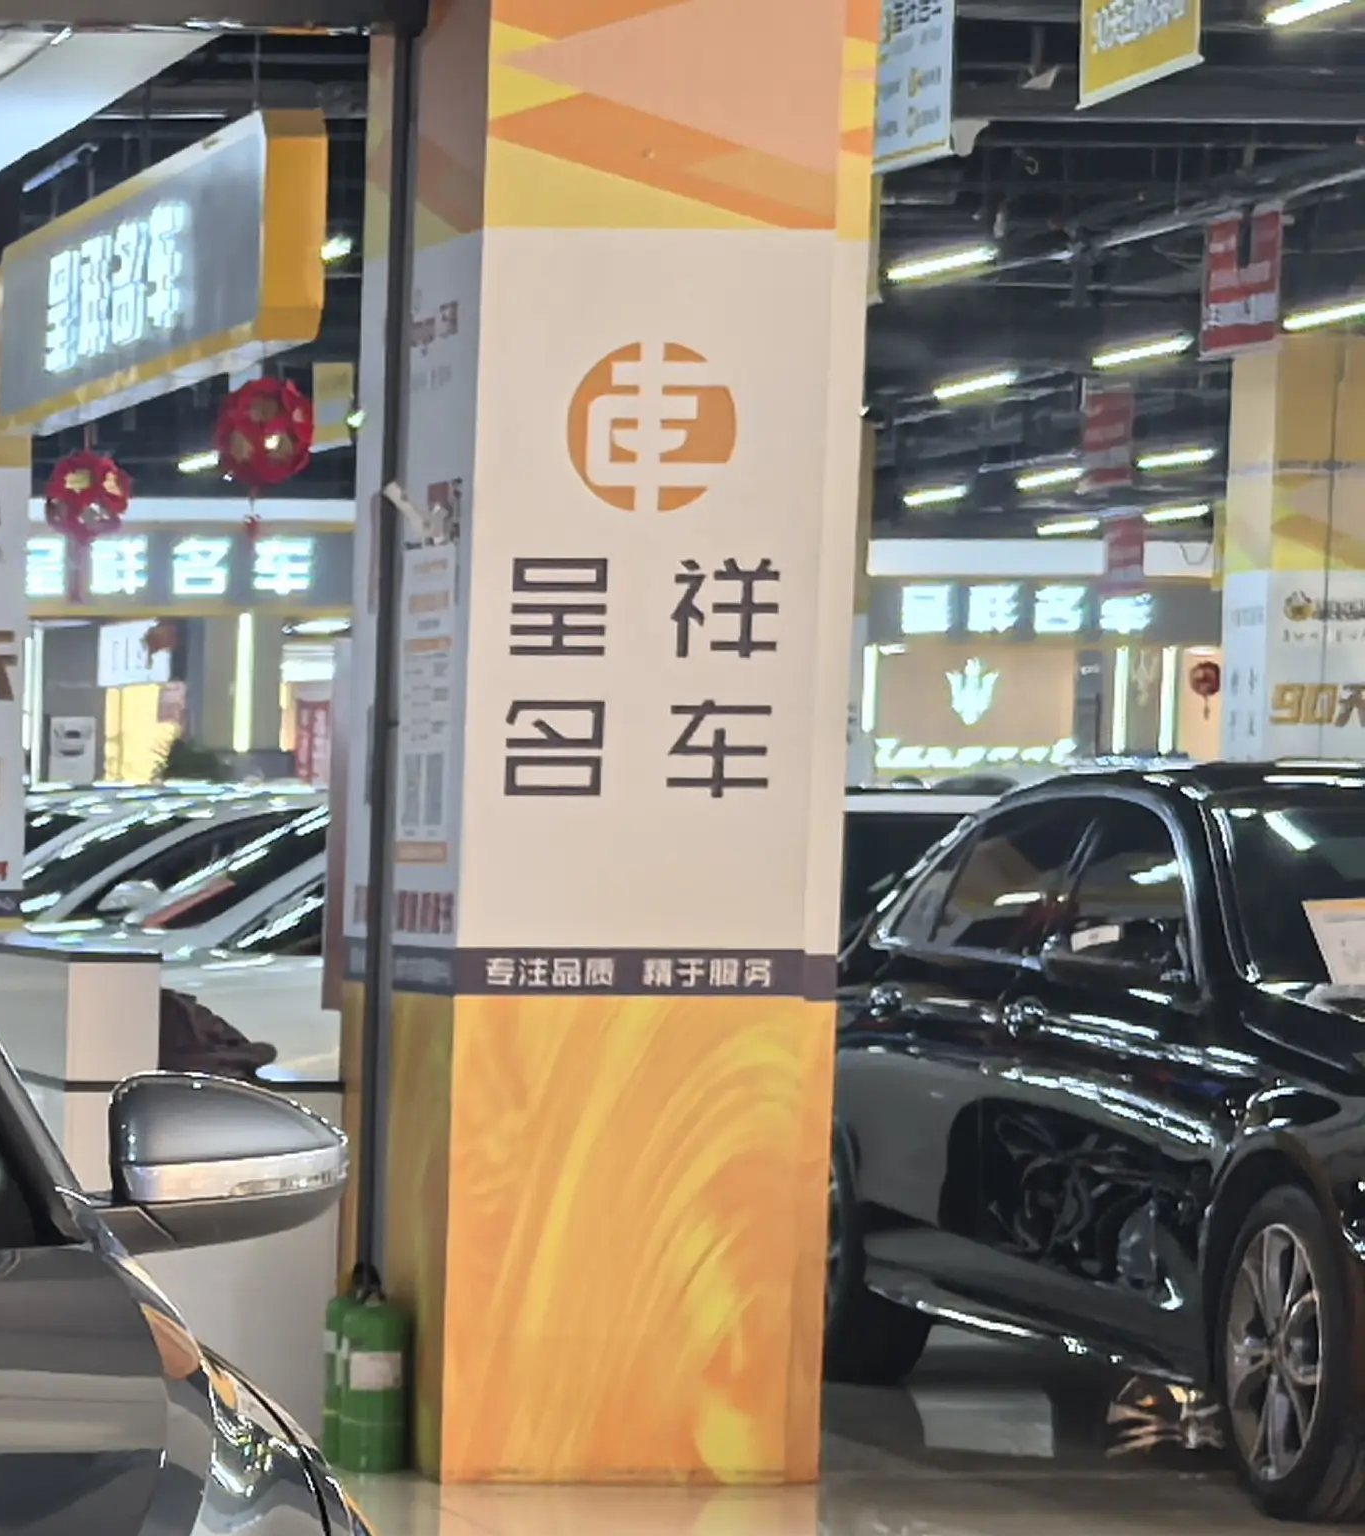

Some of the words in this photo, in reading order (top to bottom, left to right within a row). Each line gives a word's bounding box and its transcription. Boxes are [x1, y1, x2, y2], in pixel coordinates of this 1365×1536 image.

[509, 557, 781, 658] 呈祥
[503, 700, 772, 798] 名车
[486, 957, 615, 987] 专注品质
[642, 957, 773, 988] 精于服务
